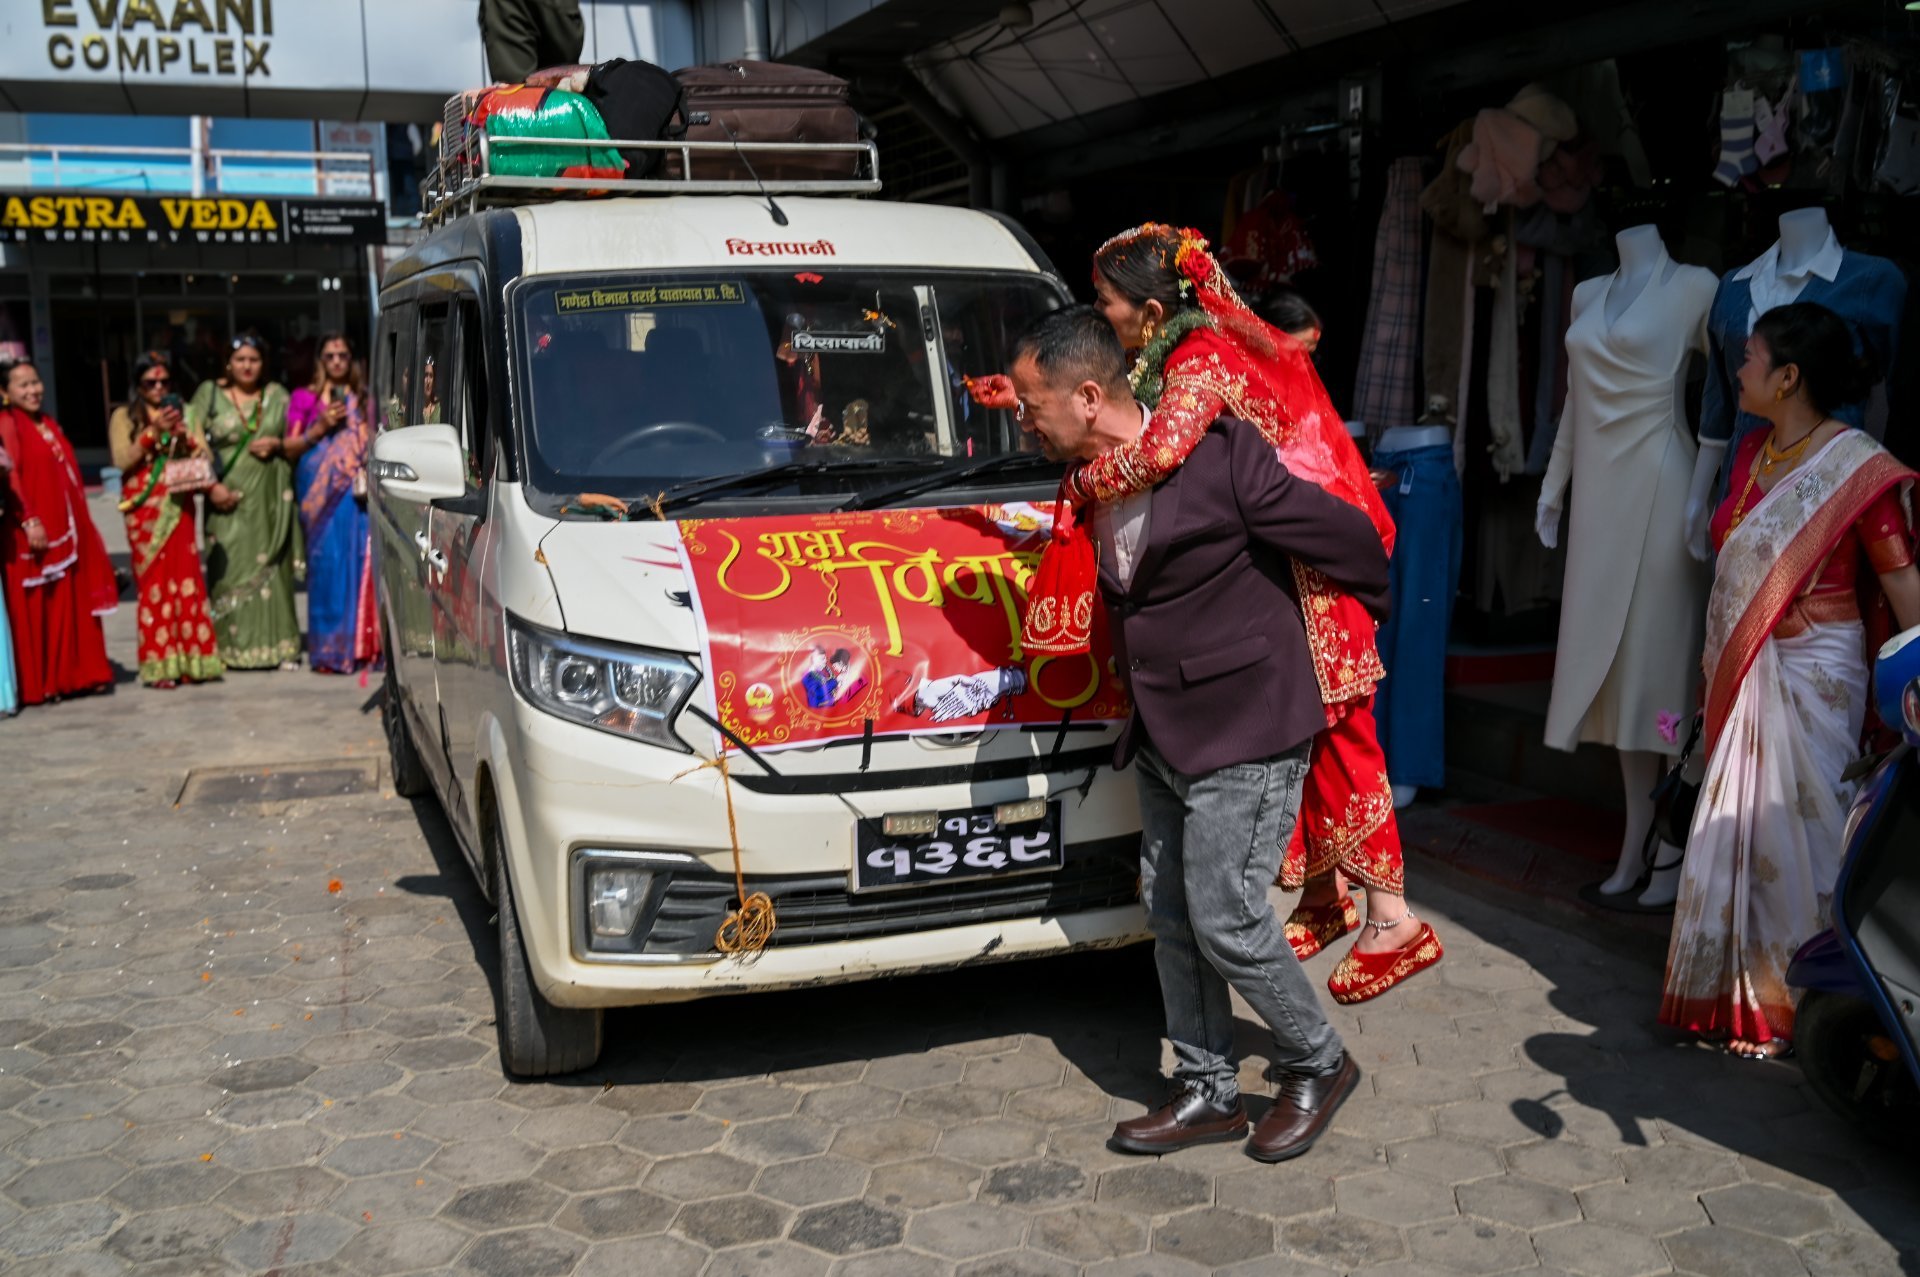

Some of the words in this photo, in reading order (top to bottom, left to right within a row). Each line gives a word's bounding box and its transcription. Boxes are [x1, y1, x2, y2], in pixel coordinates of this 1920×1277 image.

[41, 0, 274, 36] EVAANI
[48, 33, 271, 76] COMPLEX
[2, 196, 146, 228] ASTRA
[161, 198, 278, 229] VEDA
[44, 229, 131, 242] WOMEN
[196, 231, 278, 242] WOMEN
[725, 238, 837, 256] चिसापानी
[560, 291, 591, 309] गणेश
[630, 286, 657, 304] तराई
[658, 287, 703, 303] यातायात
[717, 528, 847, 600] शुभ
